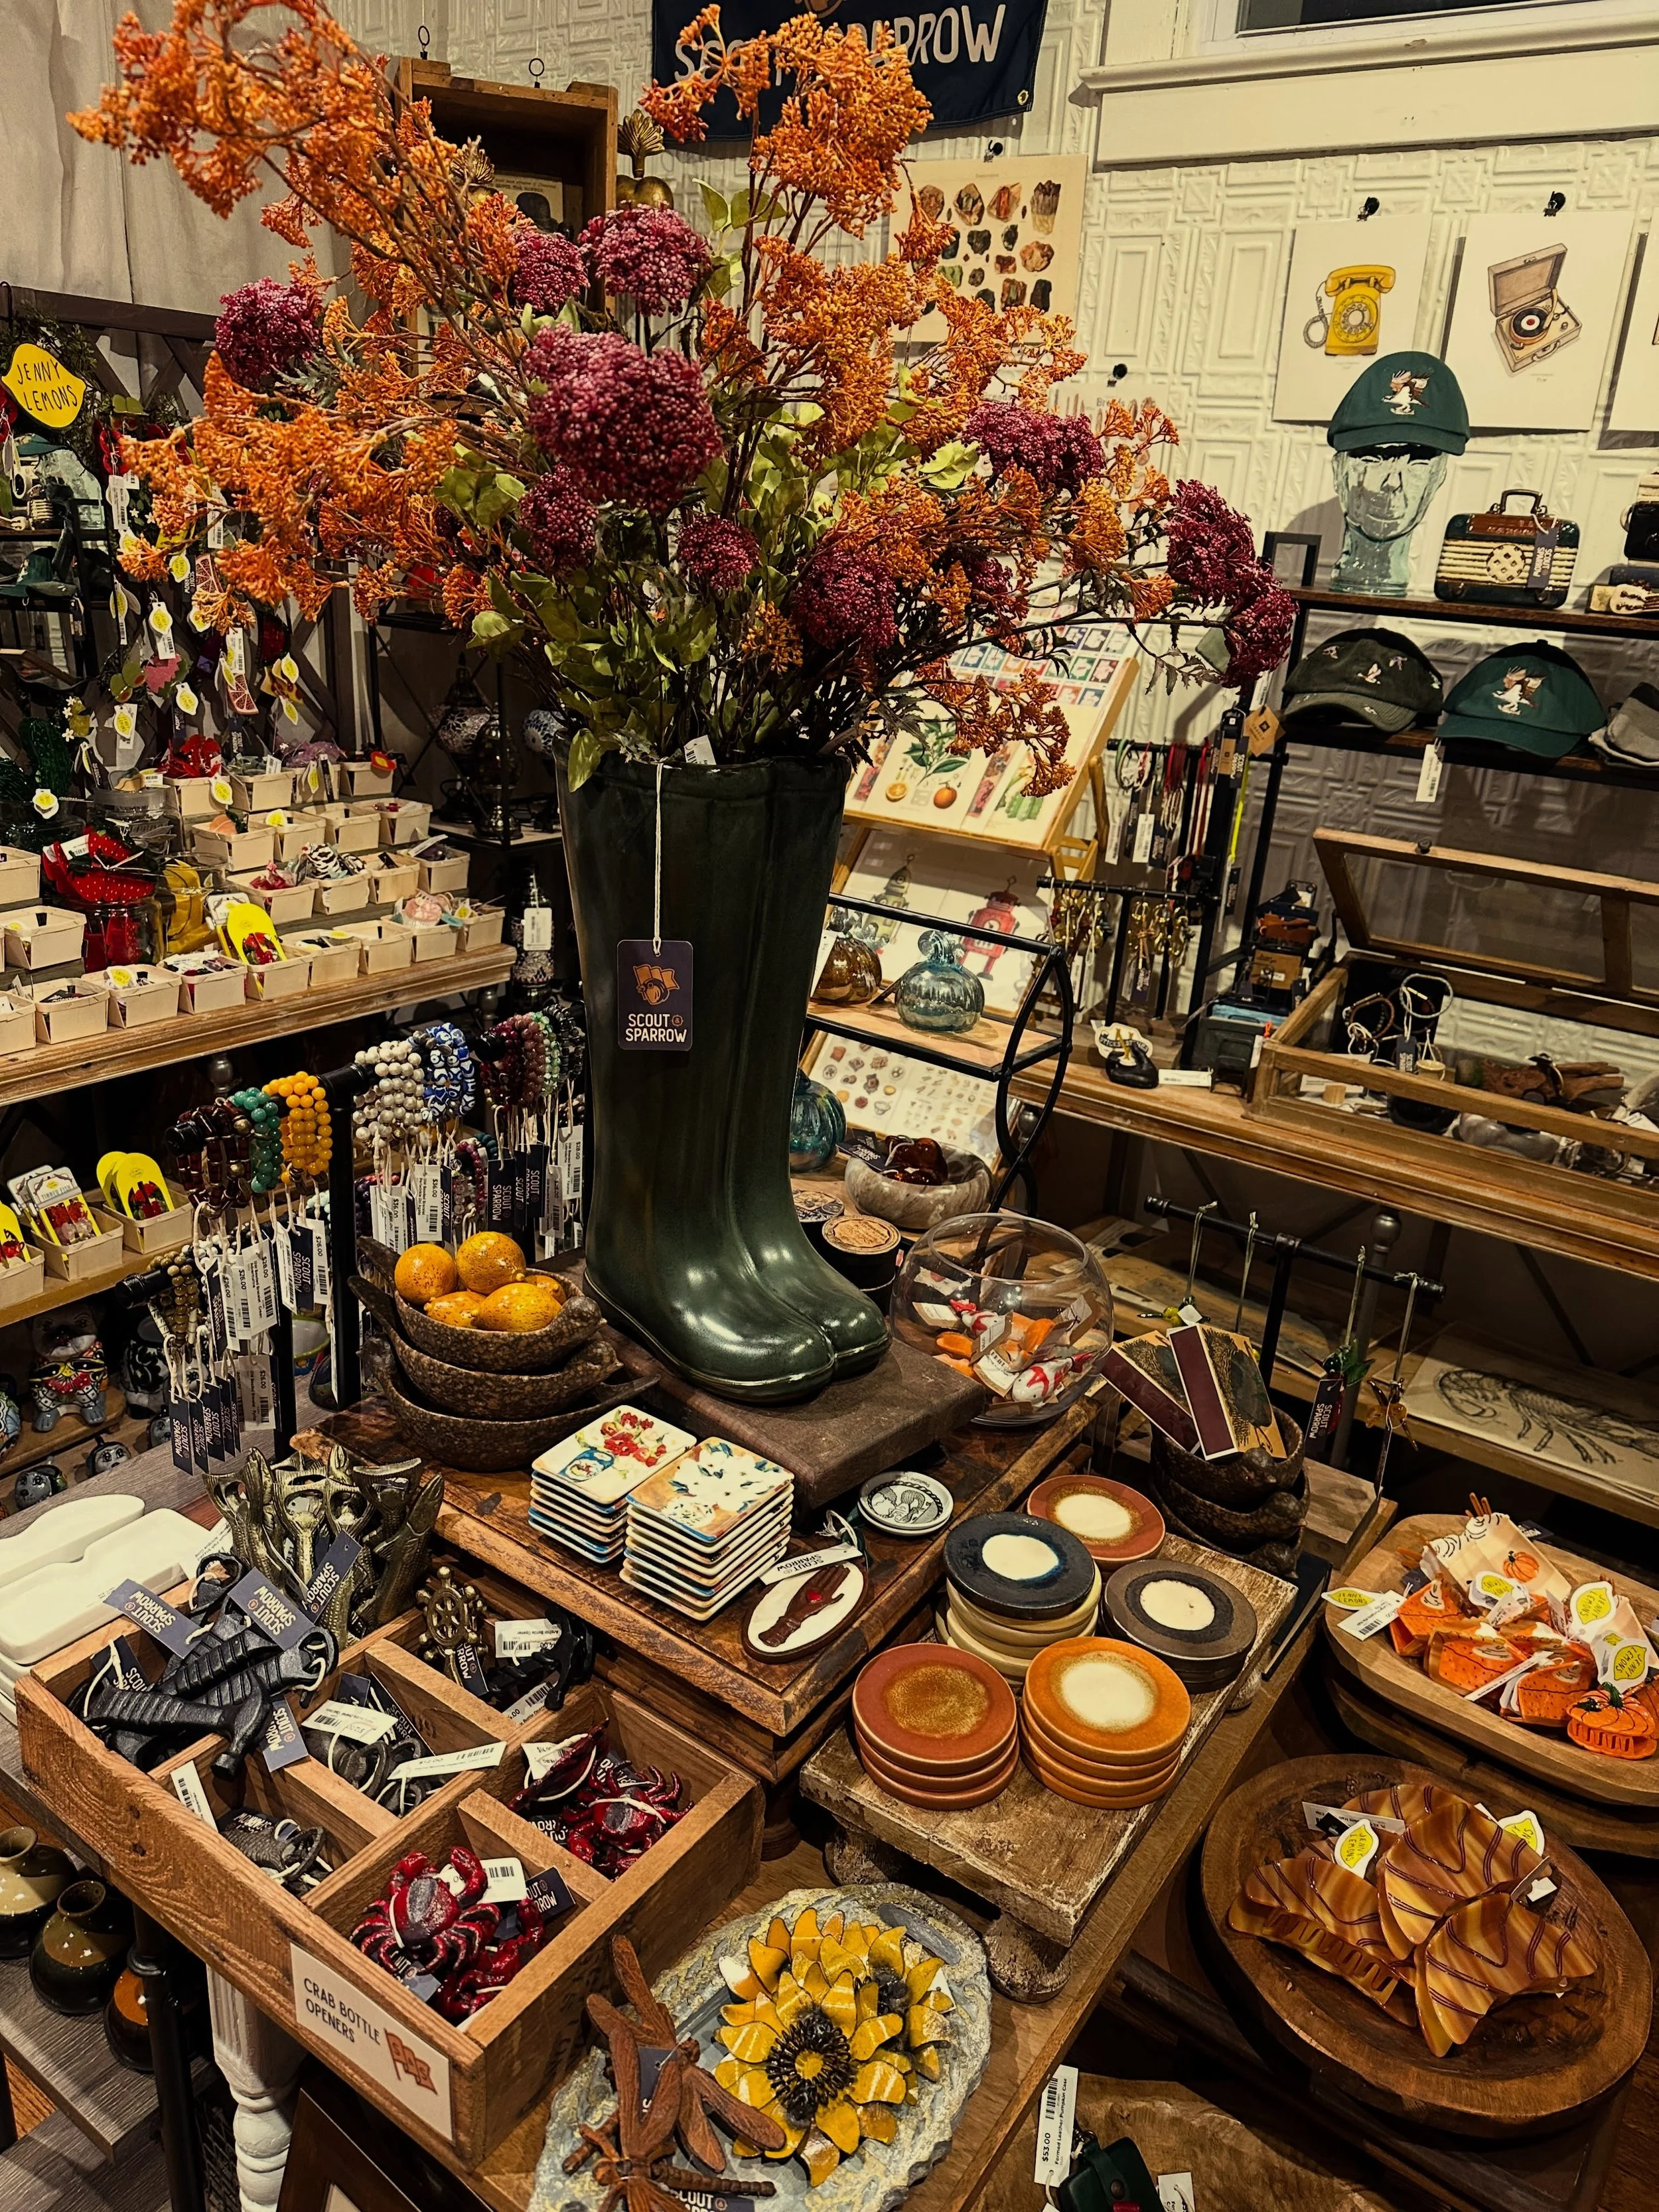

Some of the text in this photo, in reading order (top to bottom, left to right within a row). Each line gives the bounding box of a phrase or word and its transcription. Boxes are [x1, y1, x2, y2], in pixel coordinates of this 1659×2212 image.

[17, 358, 60, 385] JENNY
[24, 385, 78, 412] LEMONS
[628, 1013, 670, 1027] SCOUT
[626, 1029, 687, 1043] SPARROW
[516, 1176, 524, 1203] SCOUT
[531, 1169, 540, 1195] SCOUT
[492, 1185, 502, 1221] SPARROW
[502, 1185, 512, 1211] SCOUT
[293, 1251, 302, 1293] SPARROW
[302, 1256, 311, 1285] SCOUT
[212, 1295, 222, 1340] SPARROW
[203, 1407, 214, 1445] SPARROW
[212, 1412, 220, 1438] SCOUT
[1309, 1404, 1325, 1439] SPARROW
[1320, 1404, 1332, 1429] SCOUT
[173, 1418, 183, 1457] SPARROW
[180, 1424, 189, 1452] SCOUT
[192, 1418, 202, 1456] SPARROW
[776, 1554, 822, 1571] SPARROW
[792, 1560, 824, 1573] SCOUT
[317, 1572, 340, 1605] SCOUT
[129, 1591, 176, 1626] SPARROW
[254, 1585, 297, 1627] SPARROW
[1580, 1591, 1596, 1617] LEMONS
[1592, 1595, 1607, 1619] JENNY
[132, 1607, 165, 1633] SCOUT
[253, 1607, 285, 1635] SCOUT
[1616, 1647, 1637, 1673] LEMONS
[1626, 1654, 1642, 1677] JENNY
[273, 1707, 295, 1736] SCOUT
[391, 1704, 414, 1734] SCOUT
[1345, 1834, 1358, 1862] LEMONS
[1356, 1833, 1367, 1858] JENNY
[304, 1978, 380, 2045] CRAB BOTTLE
[305, 1999, 355, 2043] OPENERS
[678, 2191, 714, 2209] COUT
